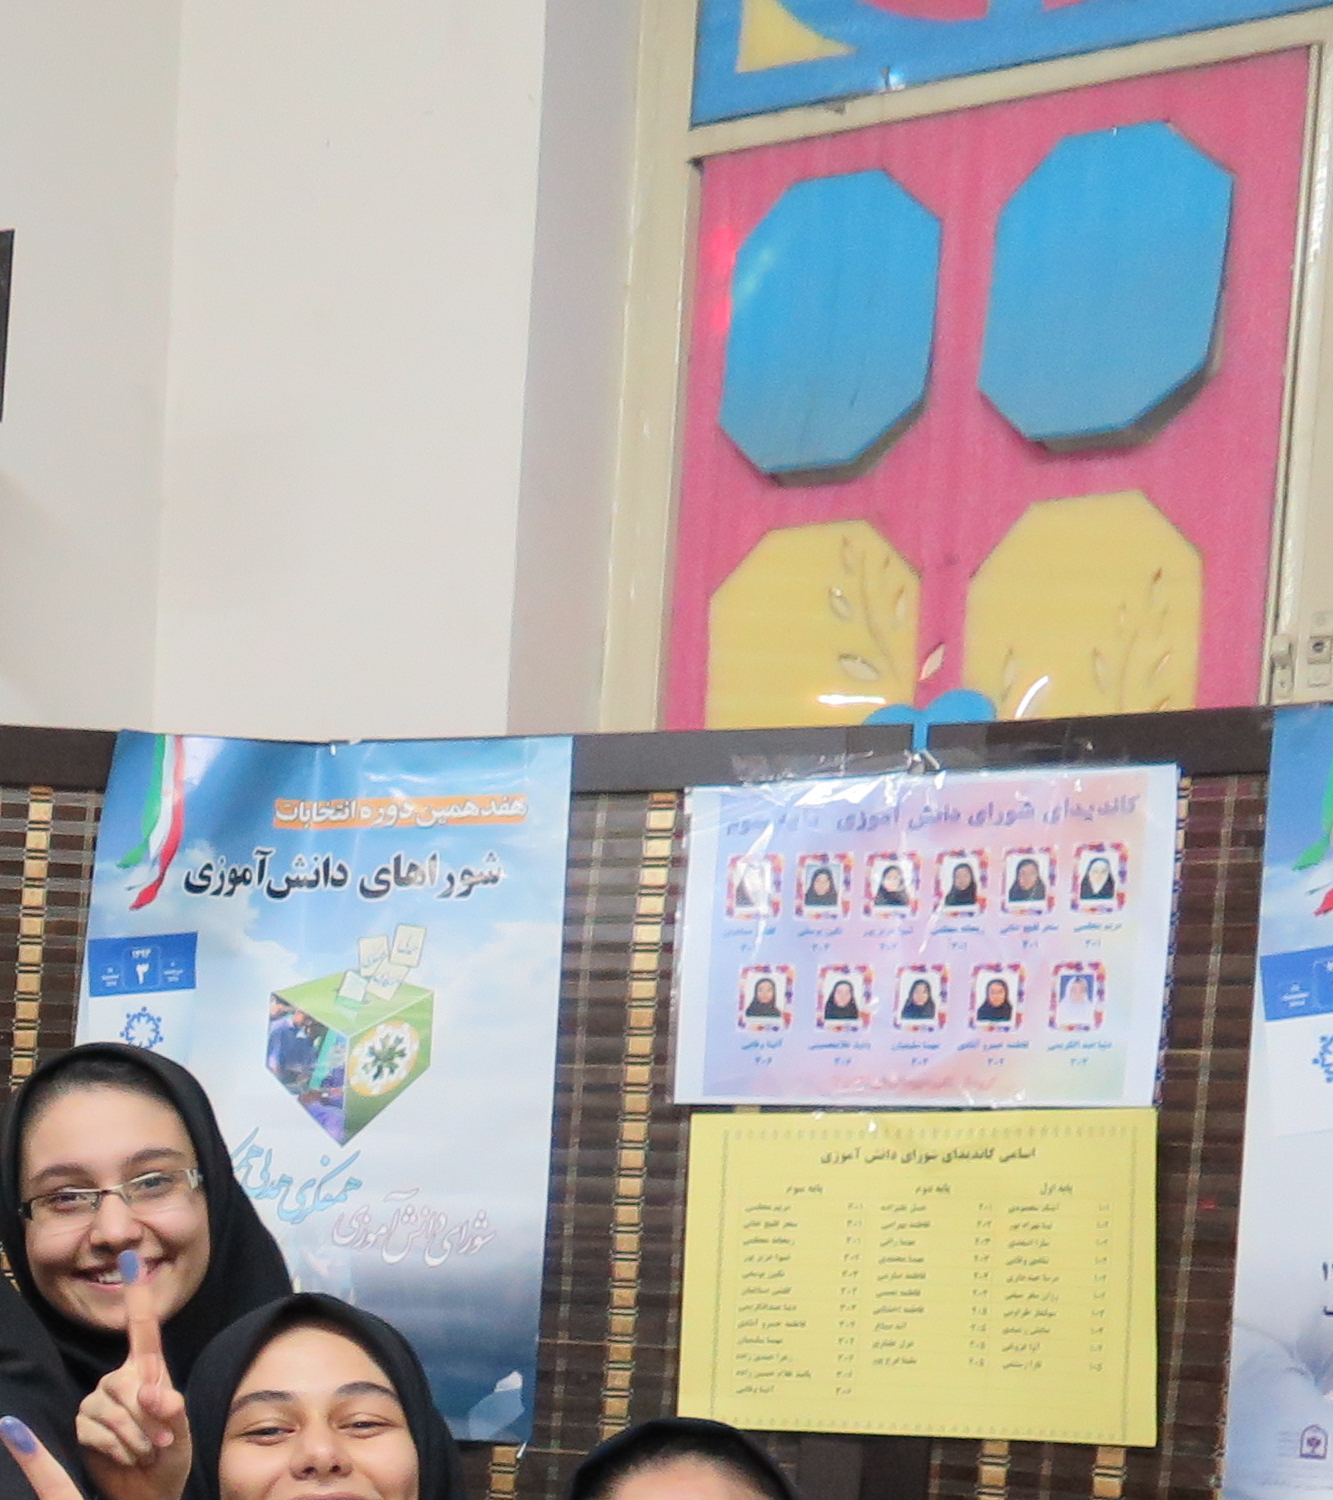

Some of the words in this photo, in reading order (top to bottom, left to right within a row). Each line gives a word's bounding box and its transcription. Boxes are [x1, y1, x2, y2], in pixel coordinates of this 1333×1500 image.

[276, 799, 357, 828] انتخابات
[360, 798, 415, 826] دوره
[358, 841, 503, 901] شوراهای
